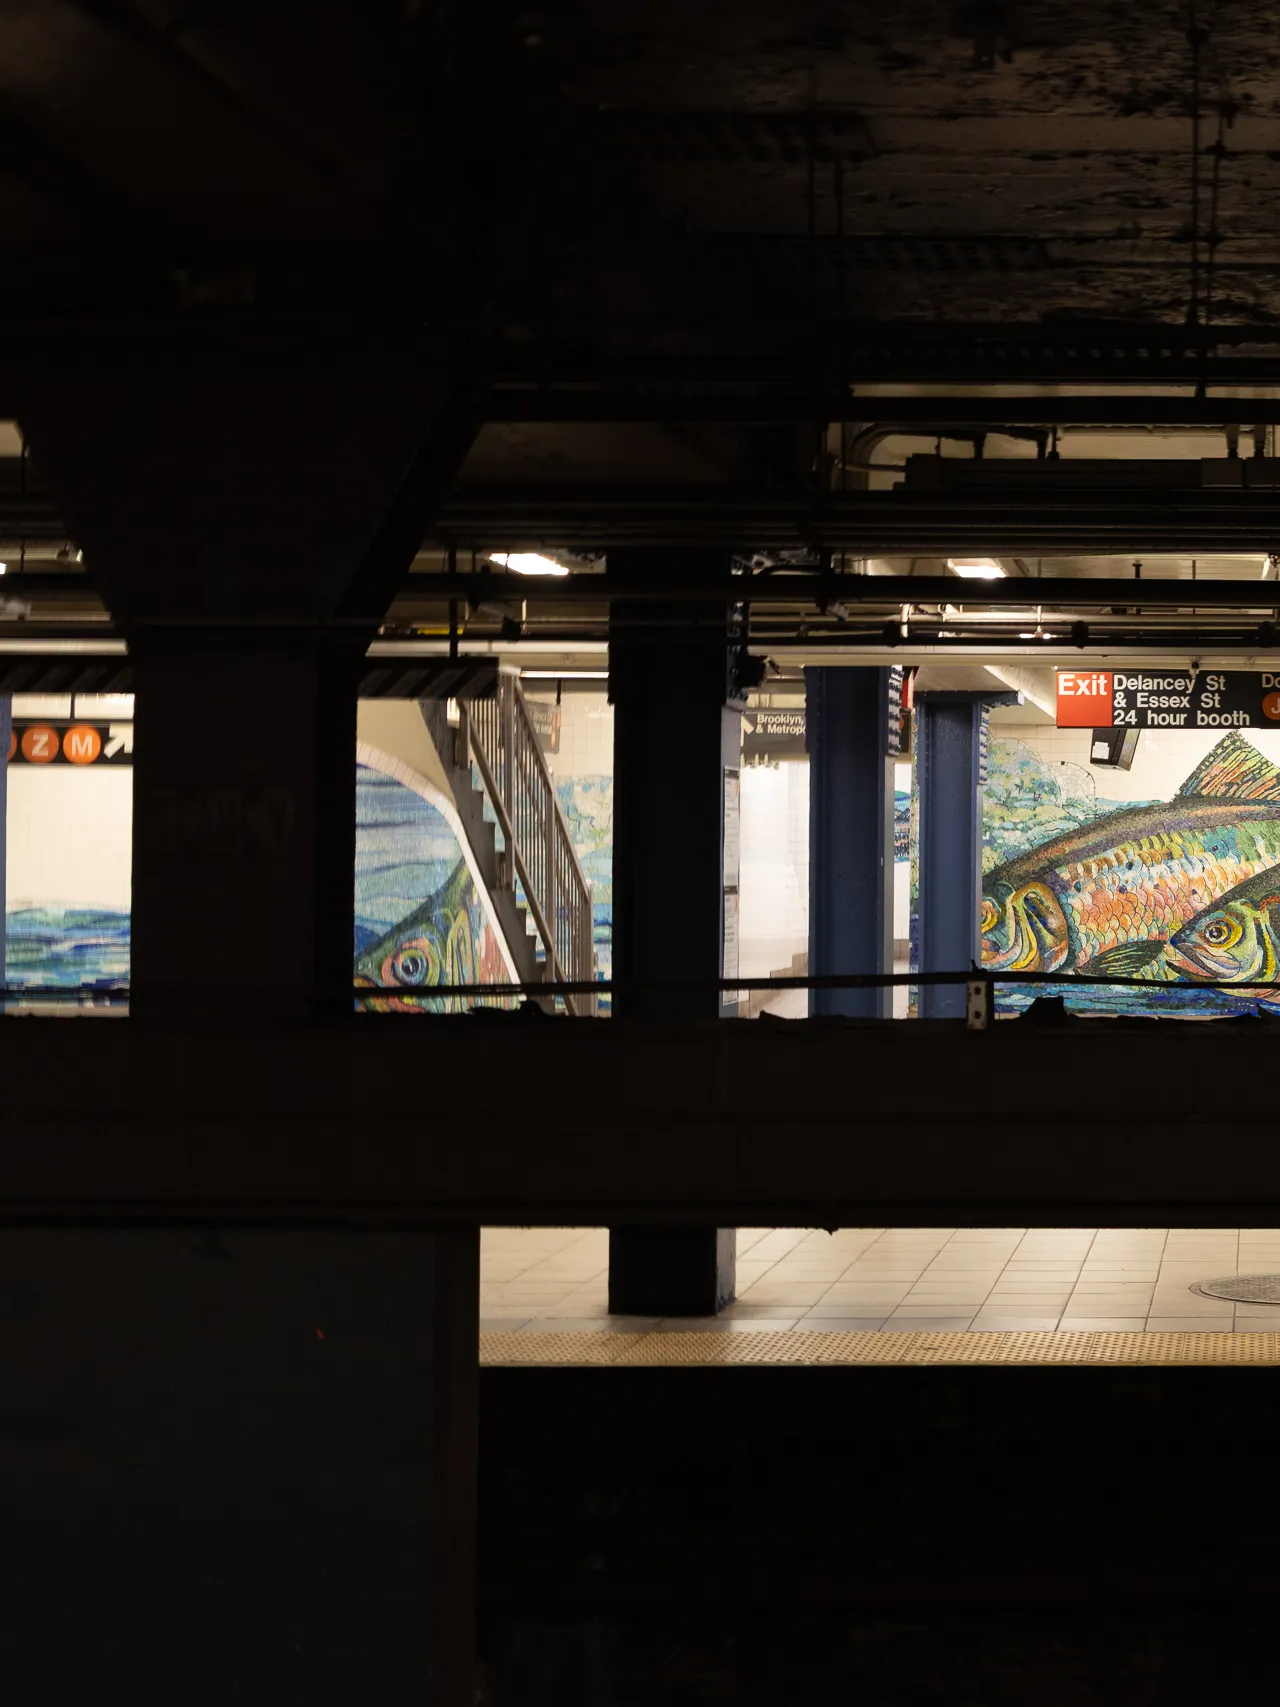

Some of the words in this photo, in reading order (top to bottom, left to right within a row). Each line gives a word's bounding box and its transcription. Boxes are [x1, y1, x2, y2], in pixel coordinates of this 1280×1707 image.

[1058, 674, 1107, 696] Exit
[1113, 675, 1196, 693] Delancey
[1206, 675, 1226, 691] St
[1113, 692, 1127, 708] &
[1136, 693, 1191, 708] Essex
[1200, 693, 1221, 708] St
[757, 713, 804, 725] Brooklyn,
[1113, 710, 1137, 725] 24
[1147, 710, 1187, 725] hour
[1196, 711, 1250, 726] booth
[755, 724, 764, 734] &
[31, 733, 49, 756] Z
[71, 734, 93, 756] M
